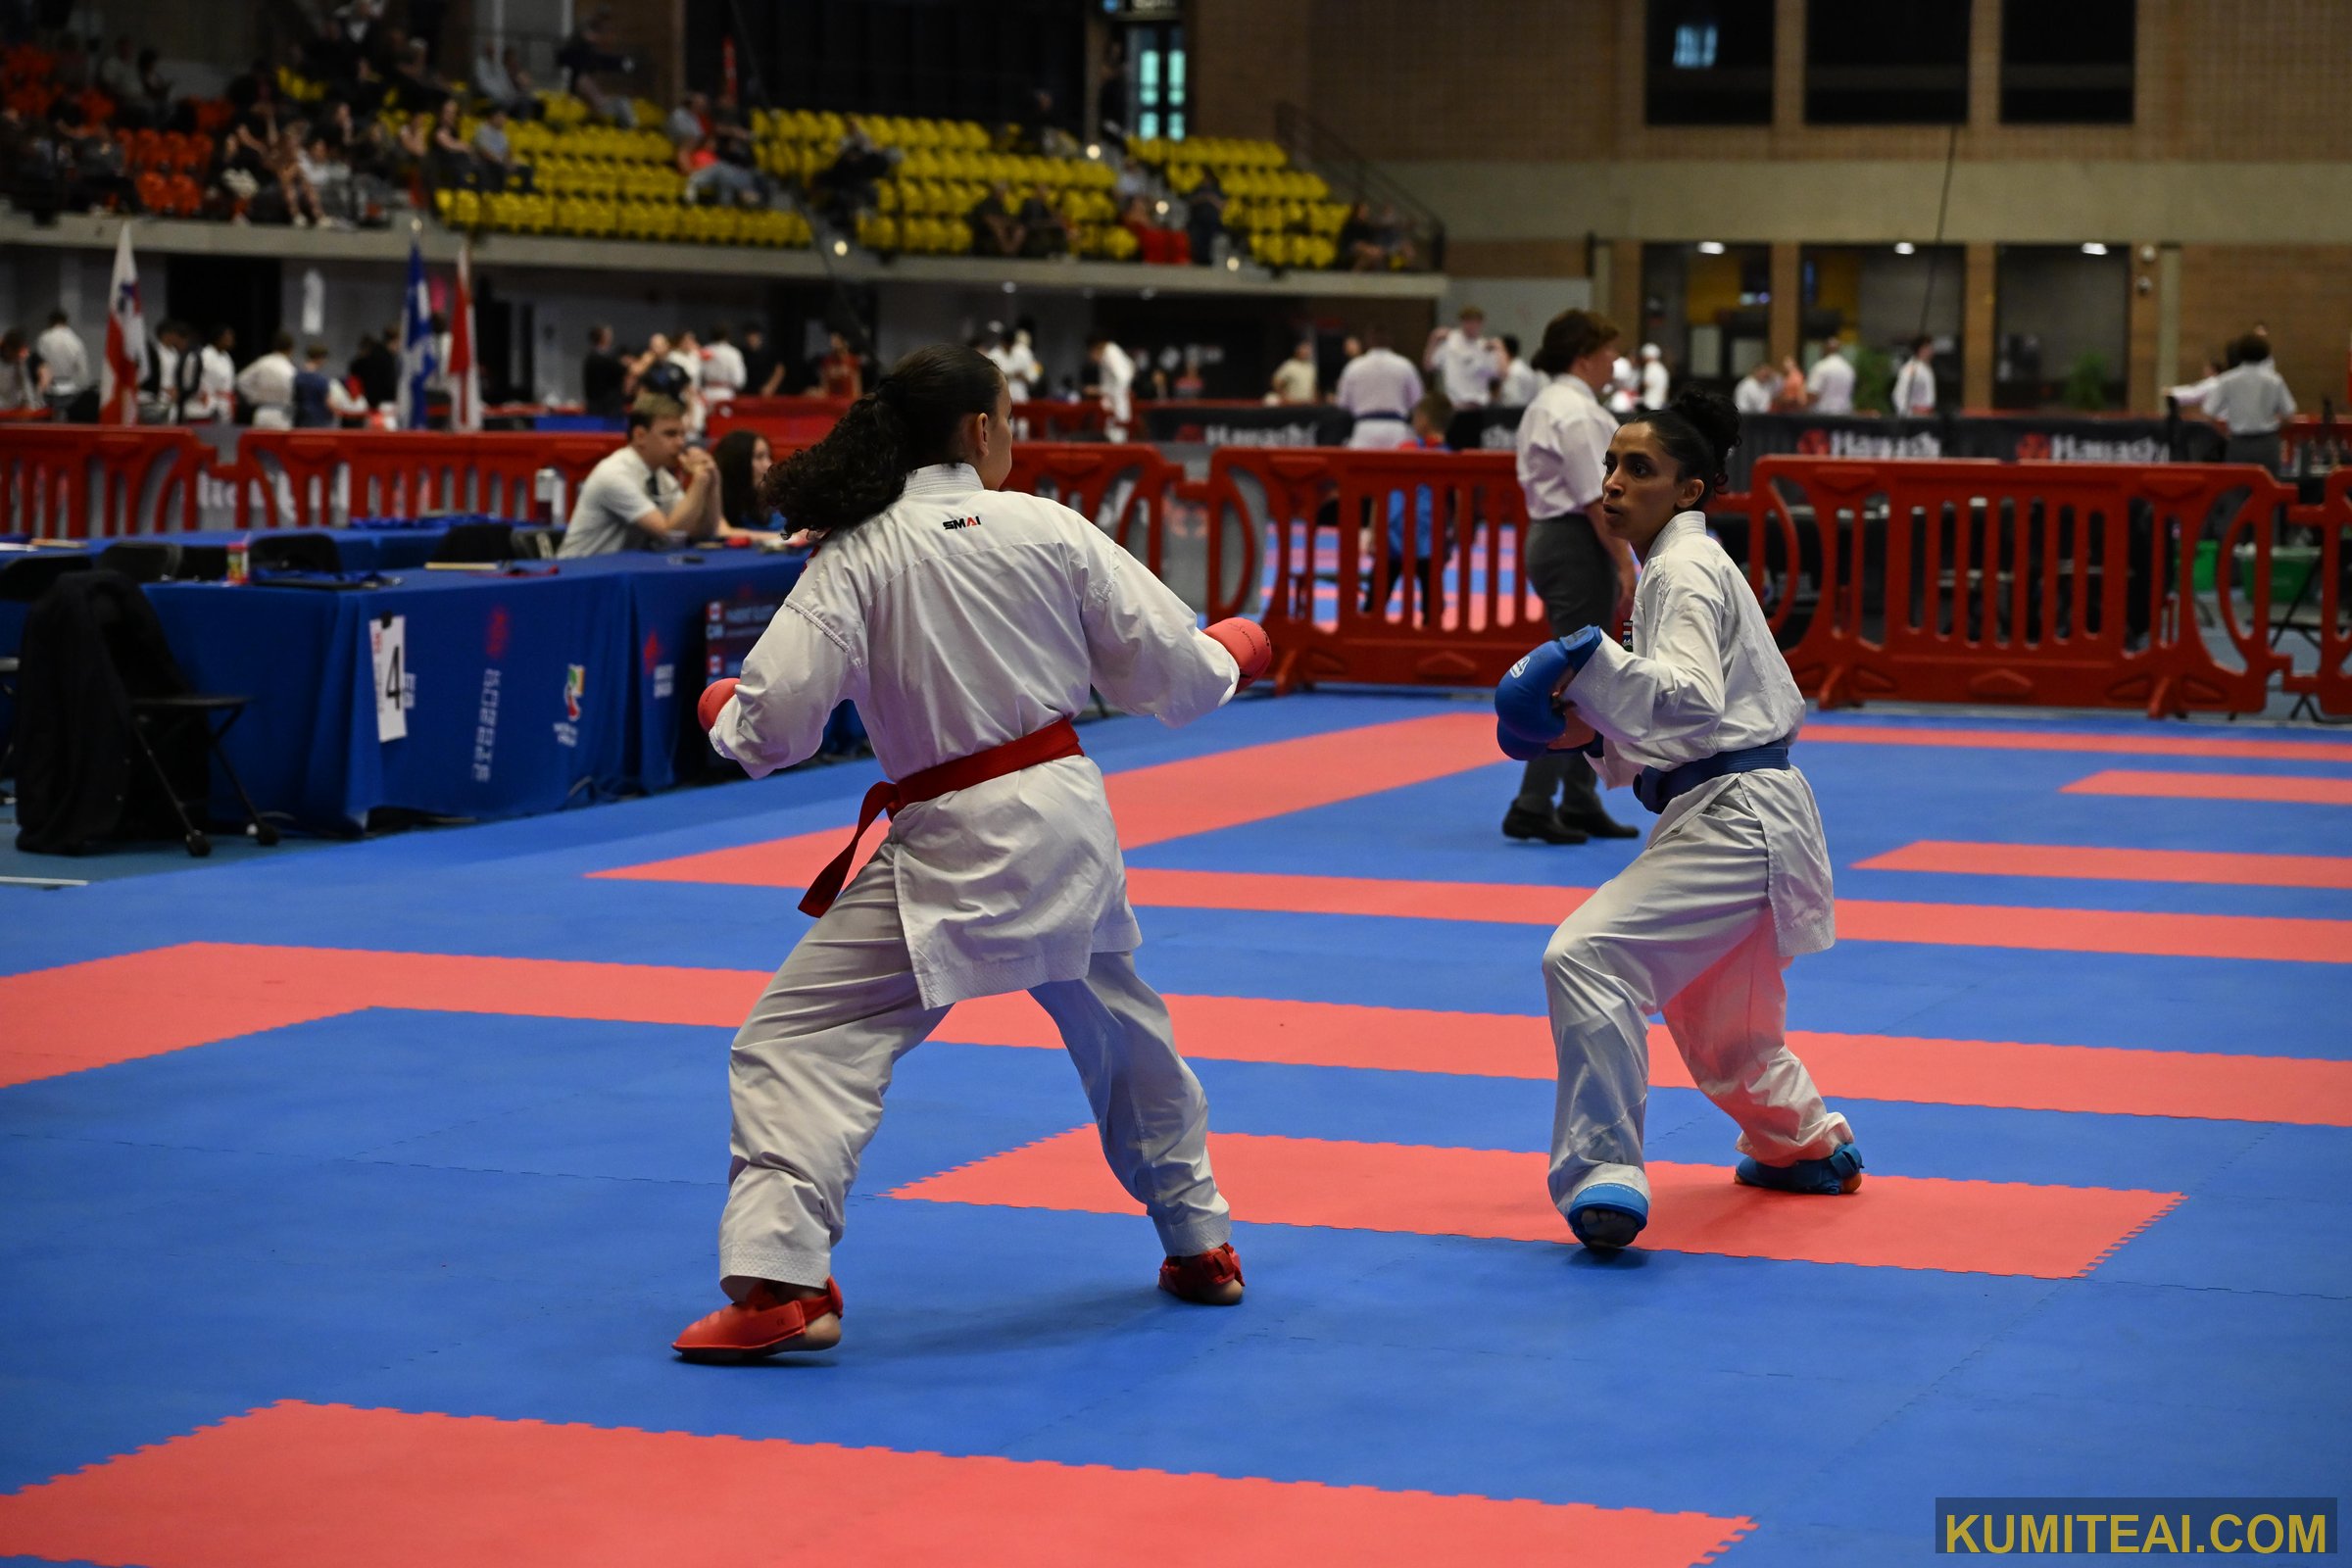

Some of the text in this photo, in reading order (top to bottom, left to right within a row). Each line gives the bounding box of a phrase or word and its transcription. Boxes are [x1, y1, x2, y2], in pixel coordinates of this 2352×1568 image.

[1830, 429, 1942, 459] Hayash
[2051, 433, 2171, 463] Hayash
[943, 515, 981, 530] SMAI
[385, 644, 401, 710] 4
